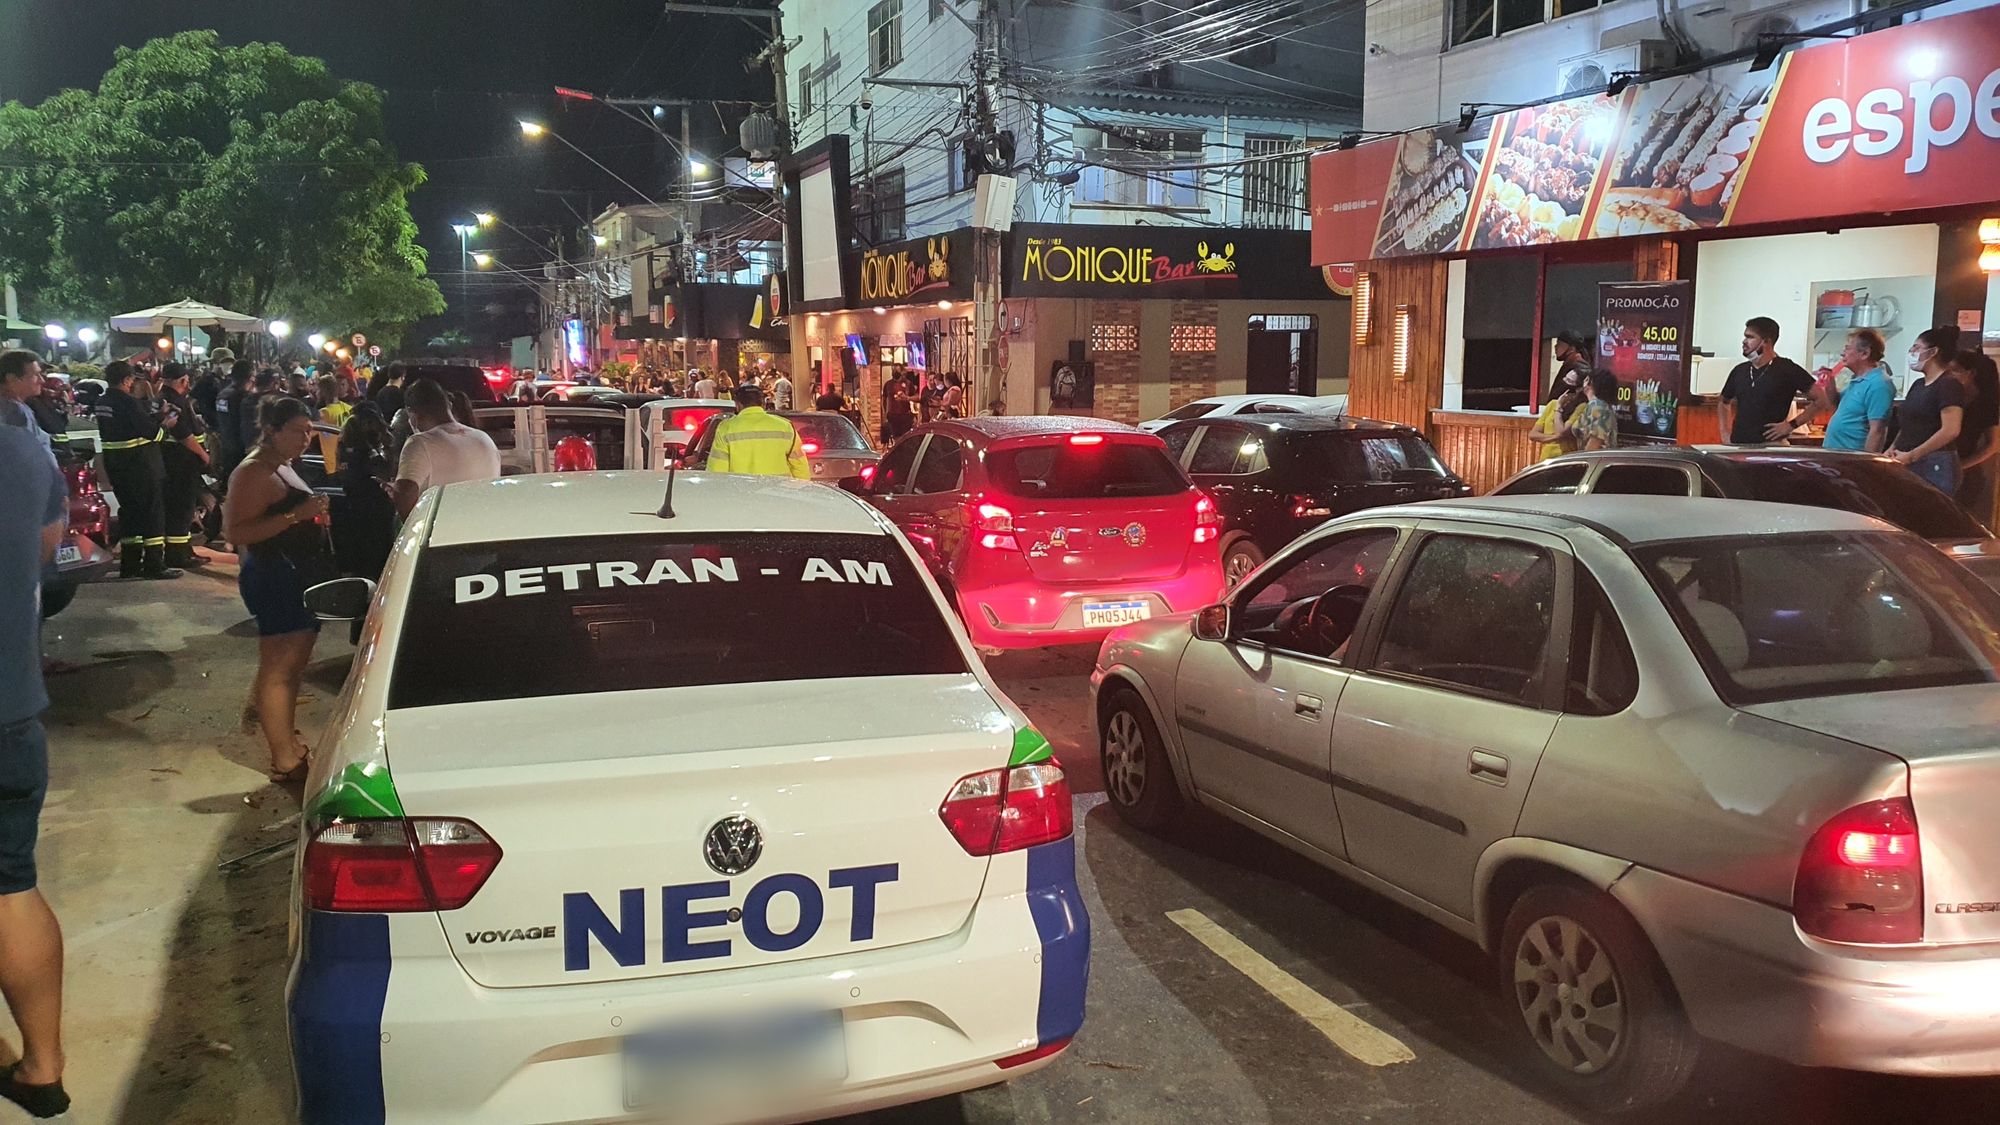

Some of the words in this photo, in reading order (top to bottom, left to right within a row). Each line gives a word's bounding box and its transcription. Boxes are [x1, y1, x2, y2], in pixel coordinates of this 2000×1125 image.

[1802, 68, 2000, 174] espe
[861, 251, 908, 300] MONIQUE
[906, 261, 925, 292] Bar
[1022, 246, 1152, 284] MONIQUE
[1149, 255, 1195, 280] Bar
[1606, 295, 1679, 309] PROMOÇÃO
[1643, 326, 1677, 342] 45,00
[455, 557, 739, 603] DETRAN
[801, 557, 893, 586] AM
[465, 926, 556, 944] VOYAGE
[563, 863, 899, 972] NEOT
